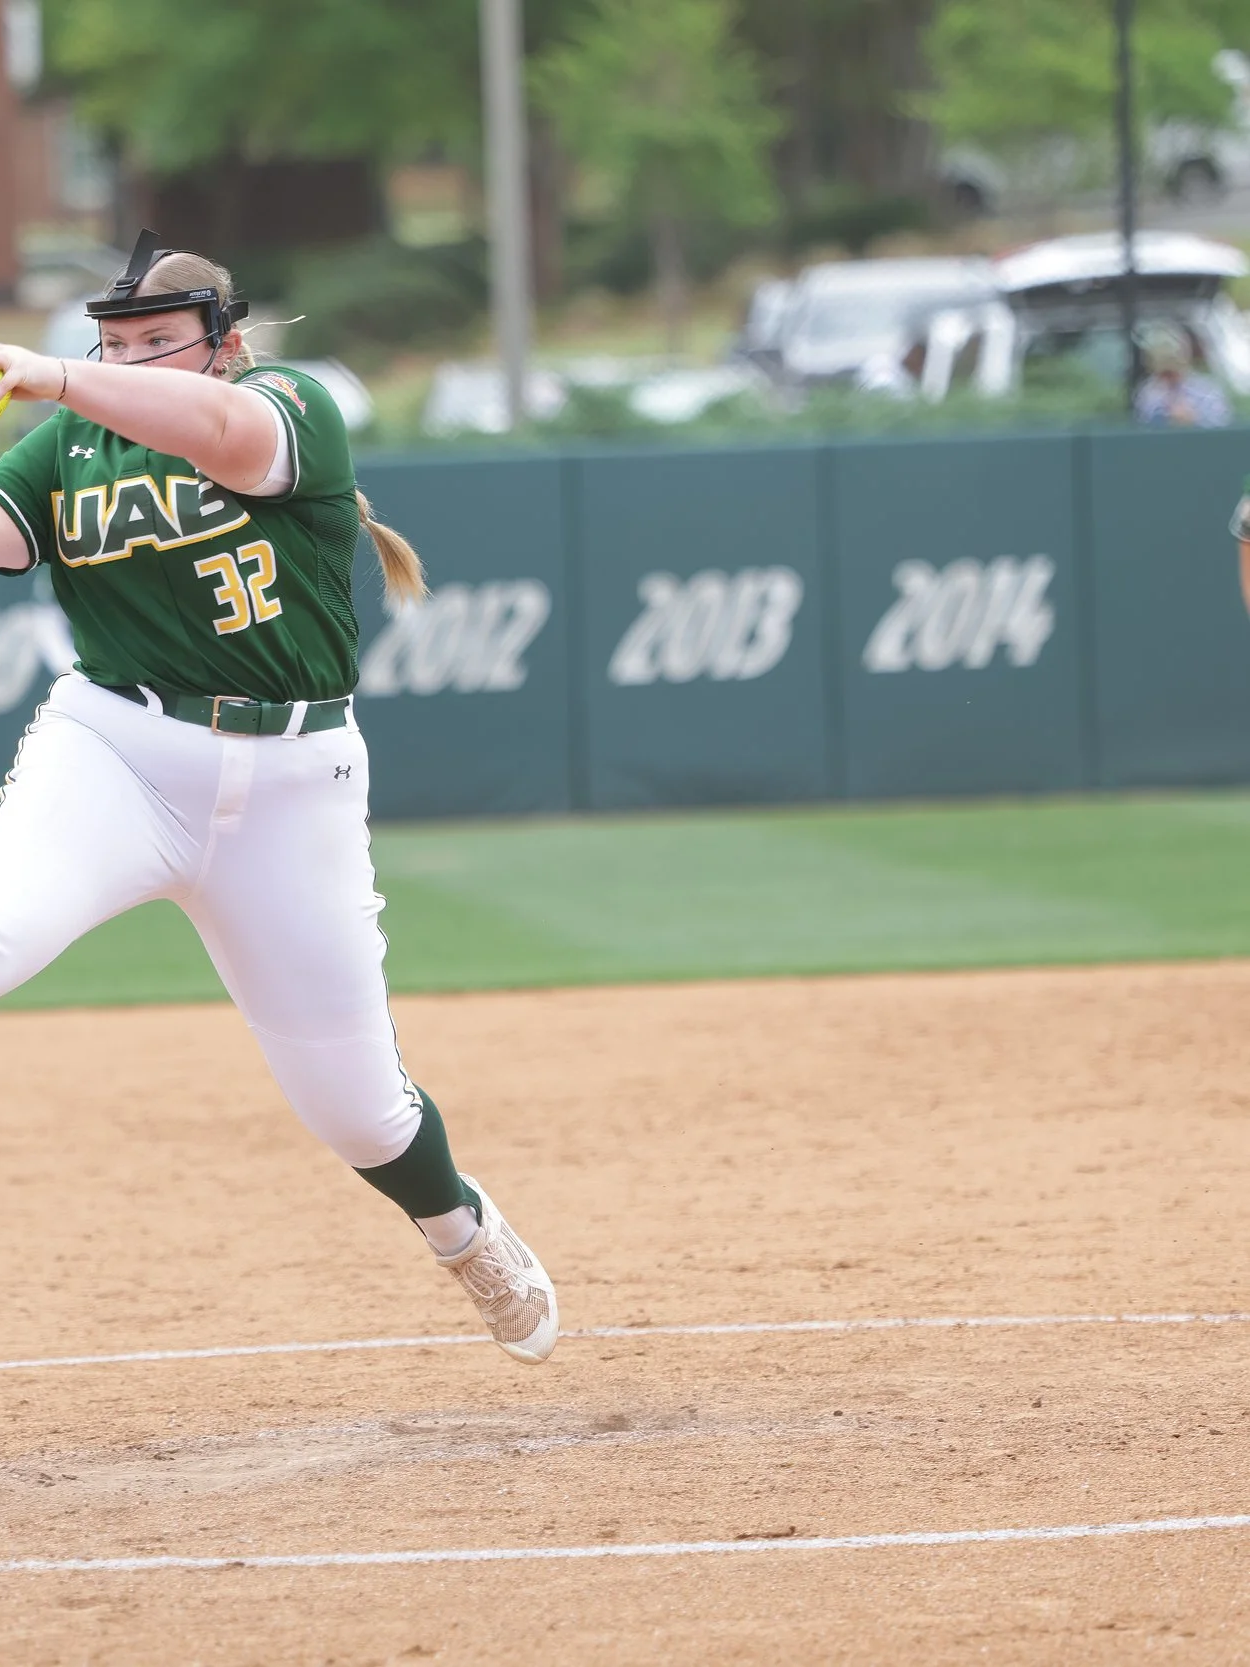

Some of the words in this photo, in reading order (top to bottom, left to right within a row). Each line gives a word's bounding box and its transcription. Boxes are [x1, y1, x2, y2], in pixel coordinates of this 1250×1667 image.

[51, 474, 251, 568] UAB
[193, 539, 283, 636] 32
[358, 577, 551, 698] 2012
[607, 563, 805, 688] 2013
[861, 553, 1056, 674] 2014
